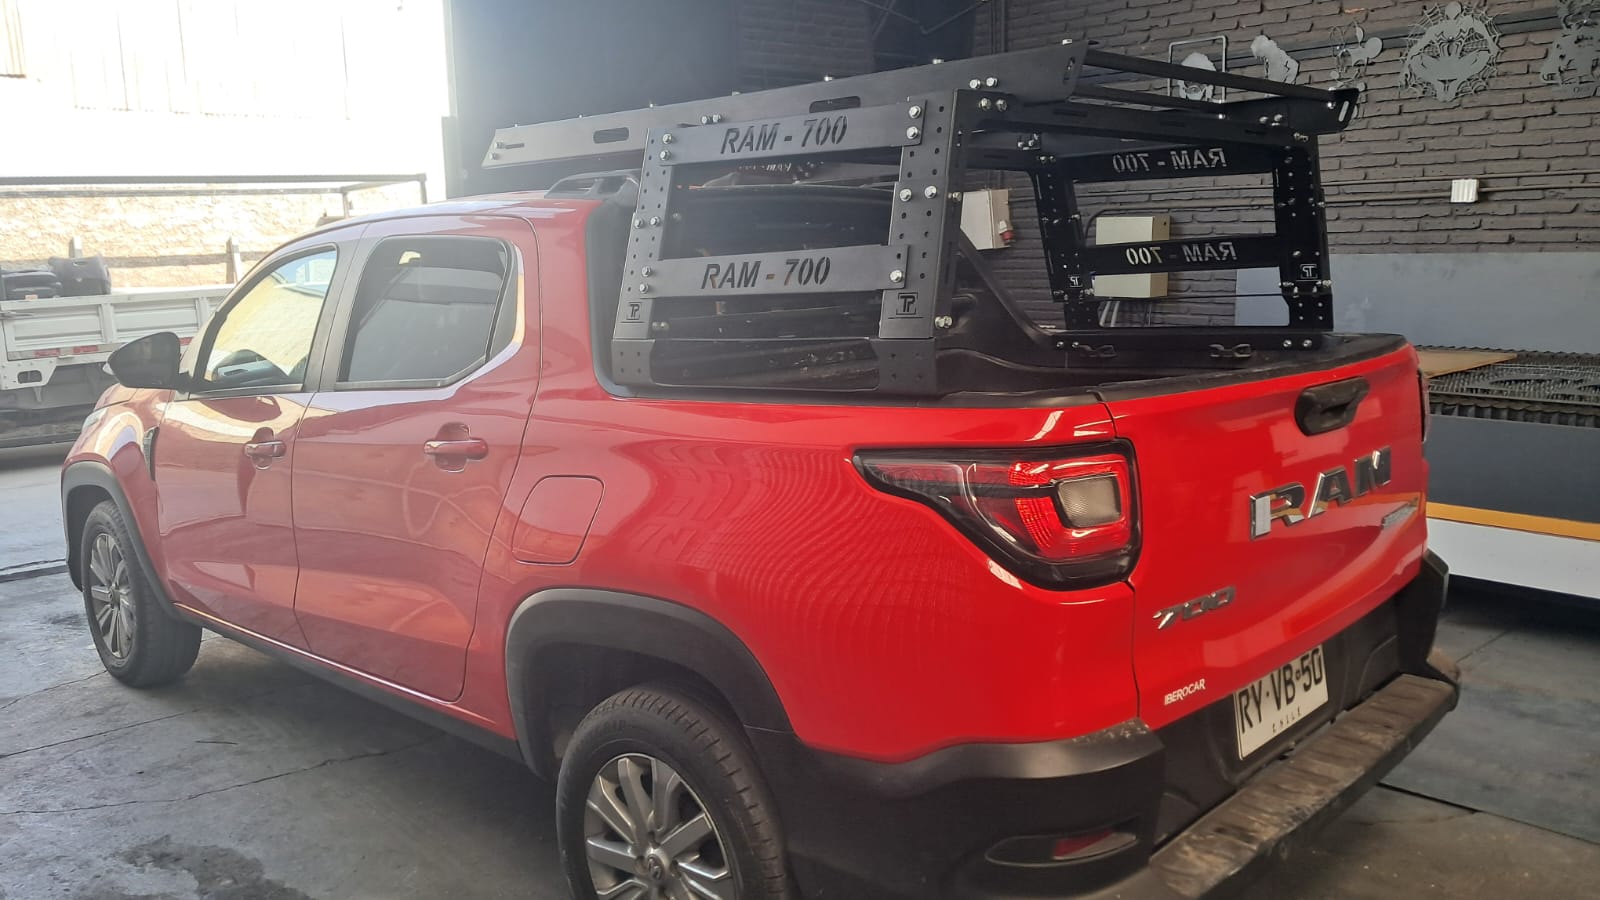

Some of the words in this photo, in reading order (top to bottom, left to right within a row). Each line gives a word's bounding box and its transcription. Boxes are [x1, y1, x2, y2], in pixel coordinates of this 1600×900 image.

[721, 123, 780, 154] RAM
[801, 115, 848, 147] 700
[701, 261, 761, 289] RAM
[784, 256, 831, 285] 700
[1250, 445, 1391, 539] RAM
[1153, 586, 1236, 629] 700
[1164, 678, 1206, 705] IBEROCAR
